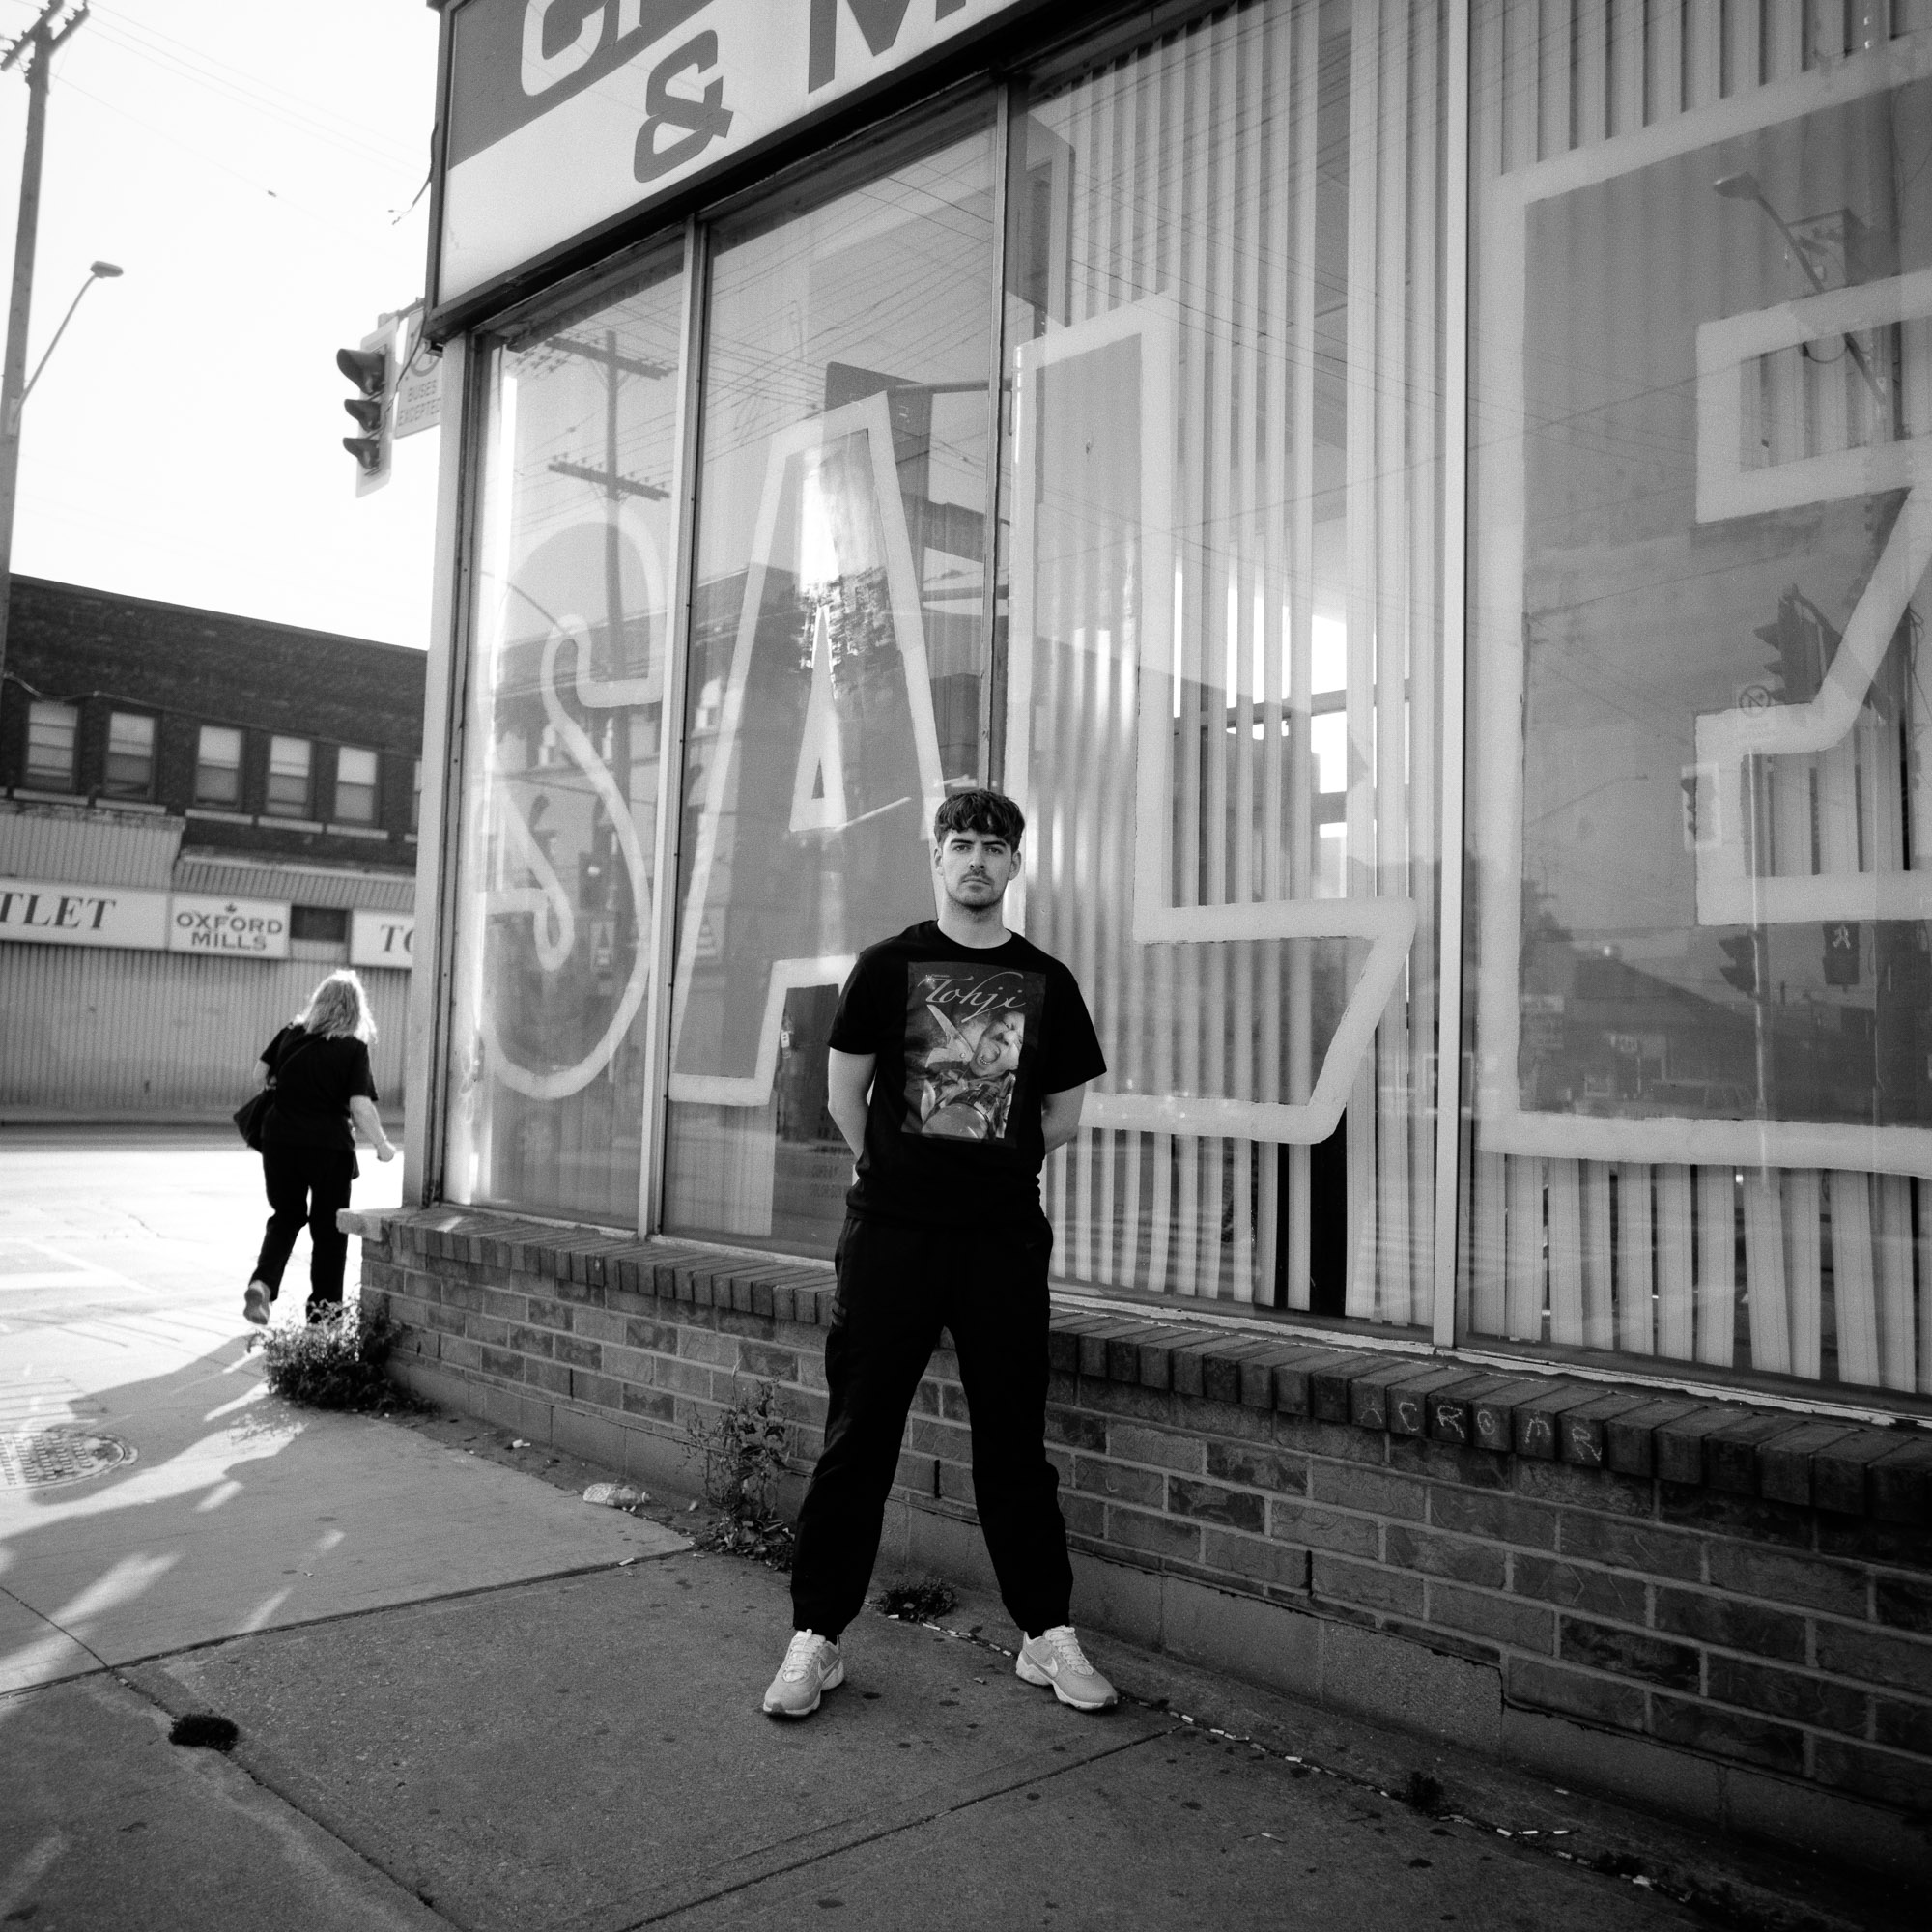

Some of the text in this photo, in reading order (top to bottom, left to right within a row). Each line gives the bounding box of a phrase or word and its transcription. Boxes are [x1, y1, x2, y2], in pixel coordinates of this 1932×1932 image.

[634, 30, 734, 183] &
[408, 380, 437, 402] BUSES
[177, 910, 283, 934] OXFORD
[192, 932, 266, 951] MILLS
